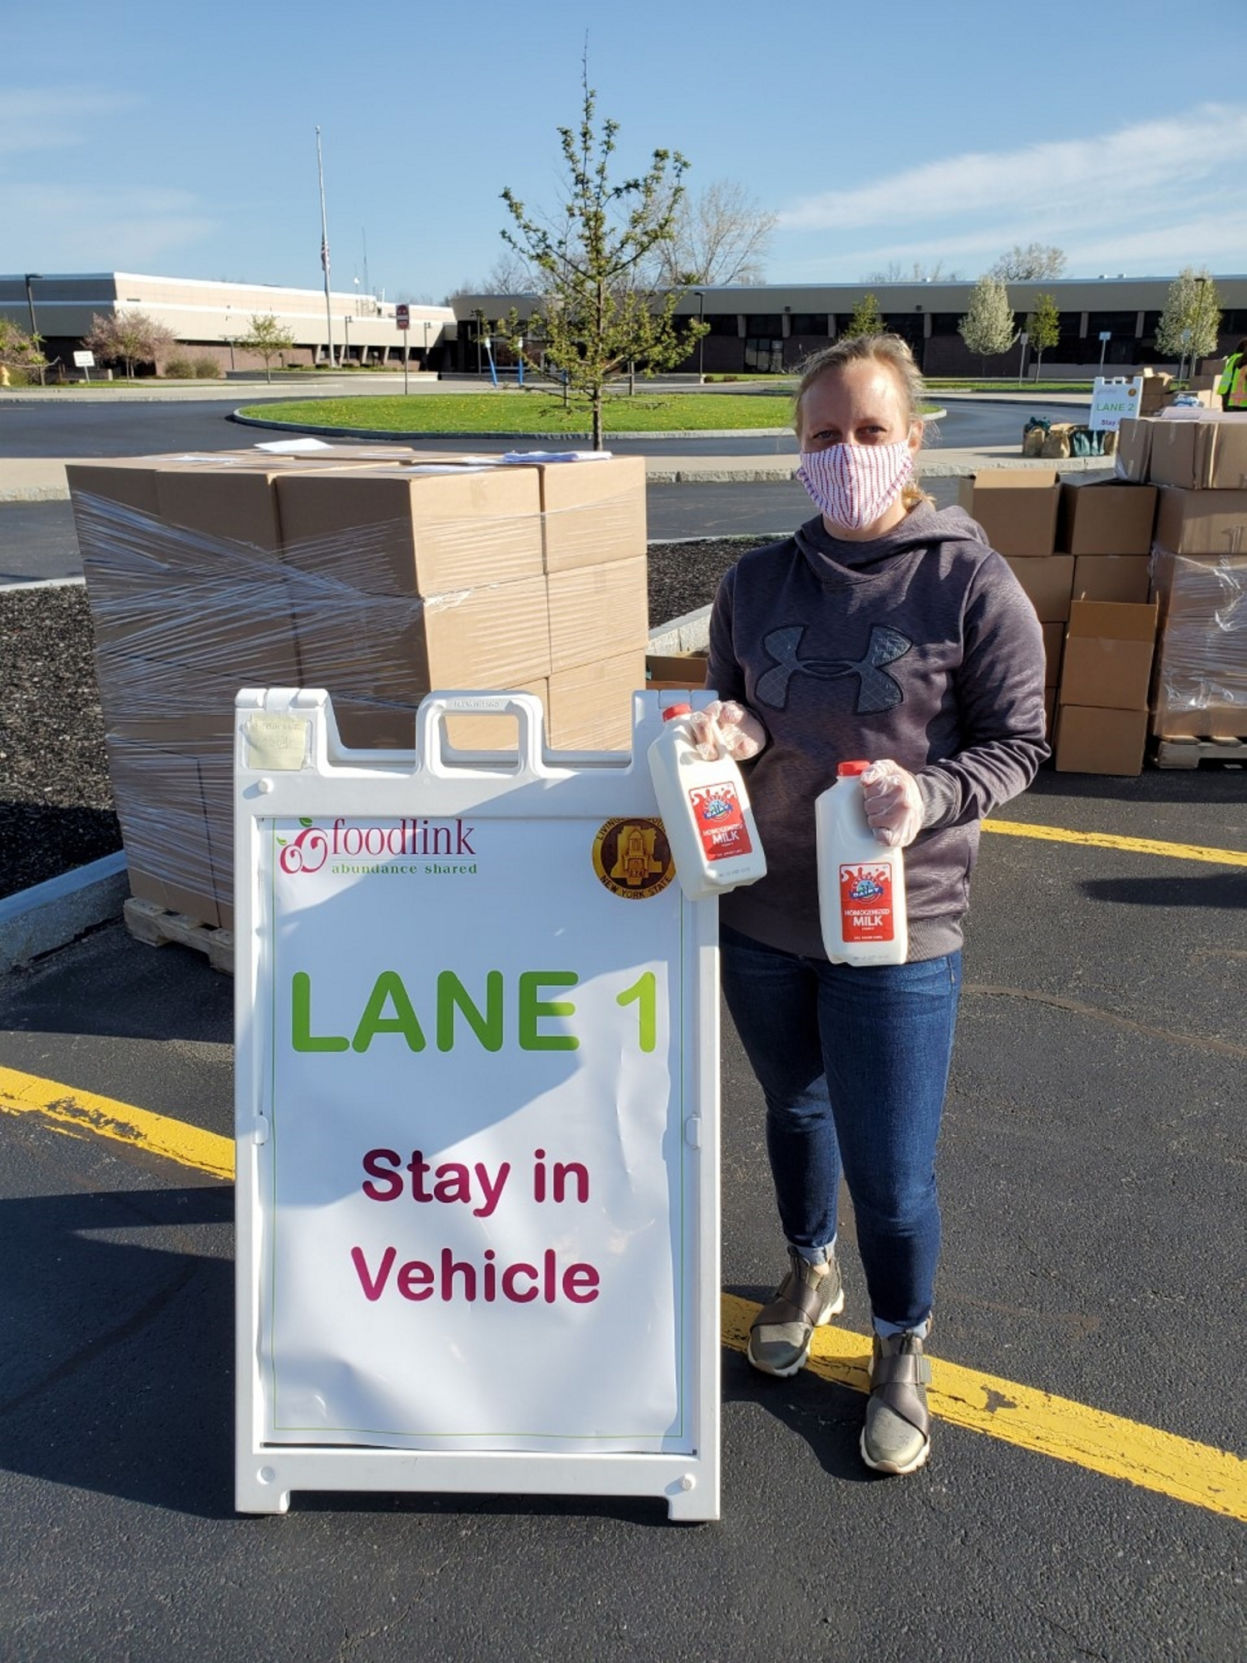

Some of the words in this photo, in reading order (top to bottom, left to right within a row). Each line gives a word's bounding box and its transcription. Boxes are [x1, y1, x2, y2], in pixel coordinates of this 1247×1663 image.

[1096, 403, 1124, 411] LANE
[1127, 403, 1135, 411] 2
[332, 818, 476, 856] foodlink
[712, 830, 740, 845] MILK
[332, 863, 417, 874] abundance
[425, 863, 477, 874] shared
[600, 875, 617, 894] NEW
[621, 890, 645, 899] YORK
[648, 877, 673, 895] STATE
[852, 887, 880, 897] DAIRY
[853, 915, 883, 927] MILK
[291, 971, 580, 1053] LANE
[616, 971, 657, 1053] 1
[362, 1149, 511, 1218] Stay
[534, 1149, 589, 1203] in
[350, 1246, 601, 1304] Vehicle
